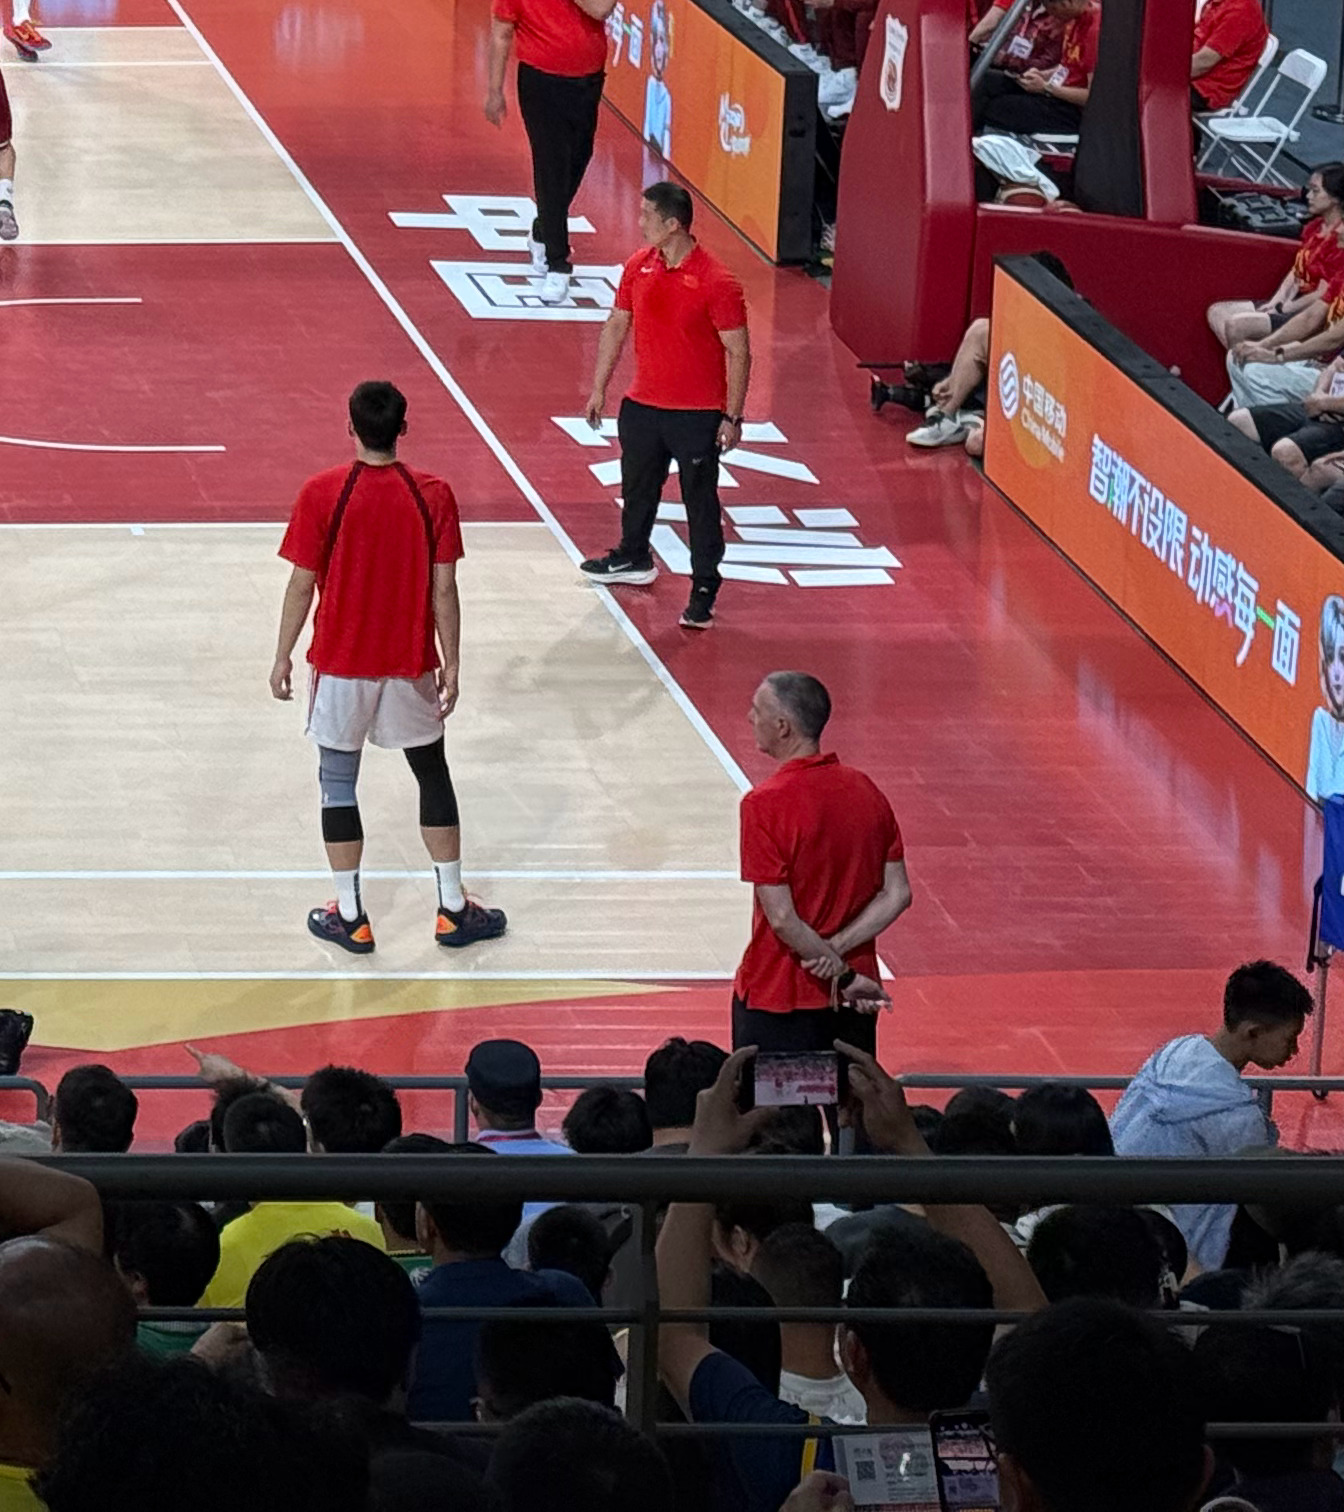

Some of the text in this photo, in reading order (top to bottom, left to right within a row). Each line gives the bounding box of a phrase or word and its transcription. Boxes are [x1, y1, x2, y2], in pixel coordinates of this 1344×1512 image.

[1022, 373, 1067, 439] 中国移动
[1090, 434, 1301, 686] 智潮不设限 动感每一面
